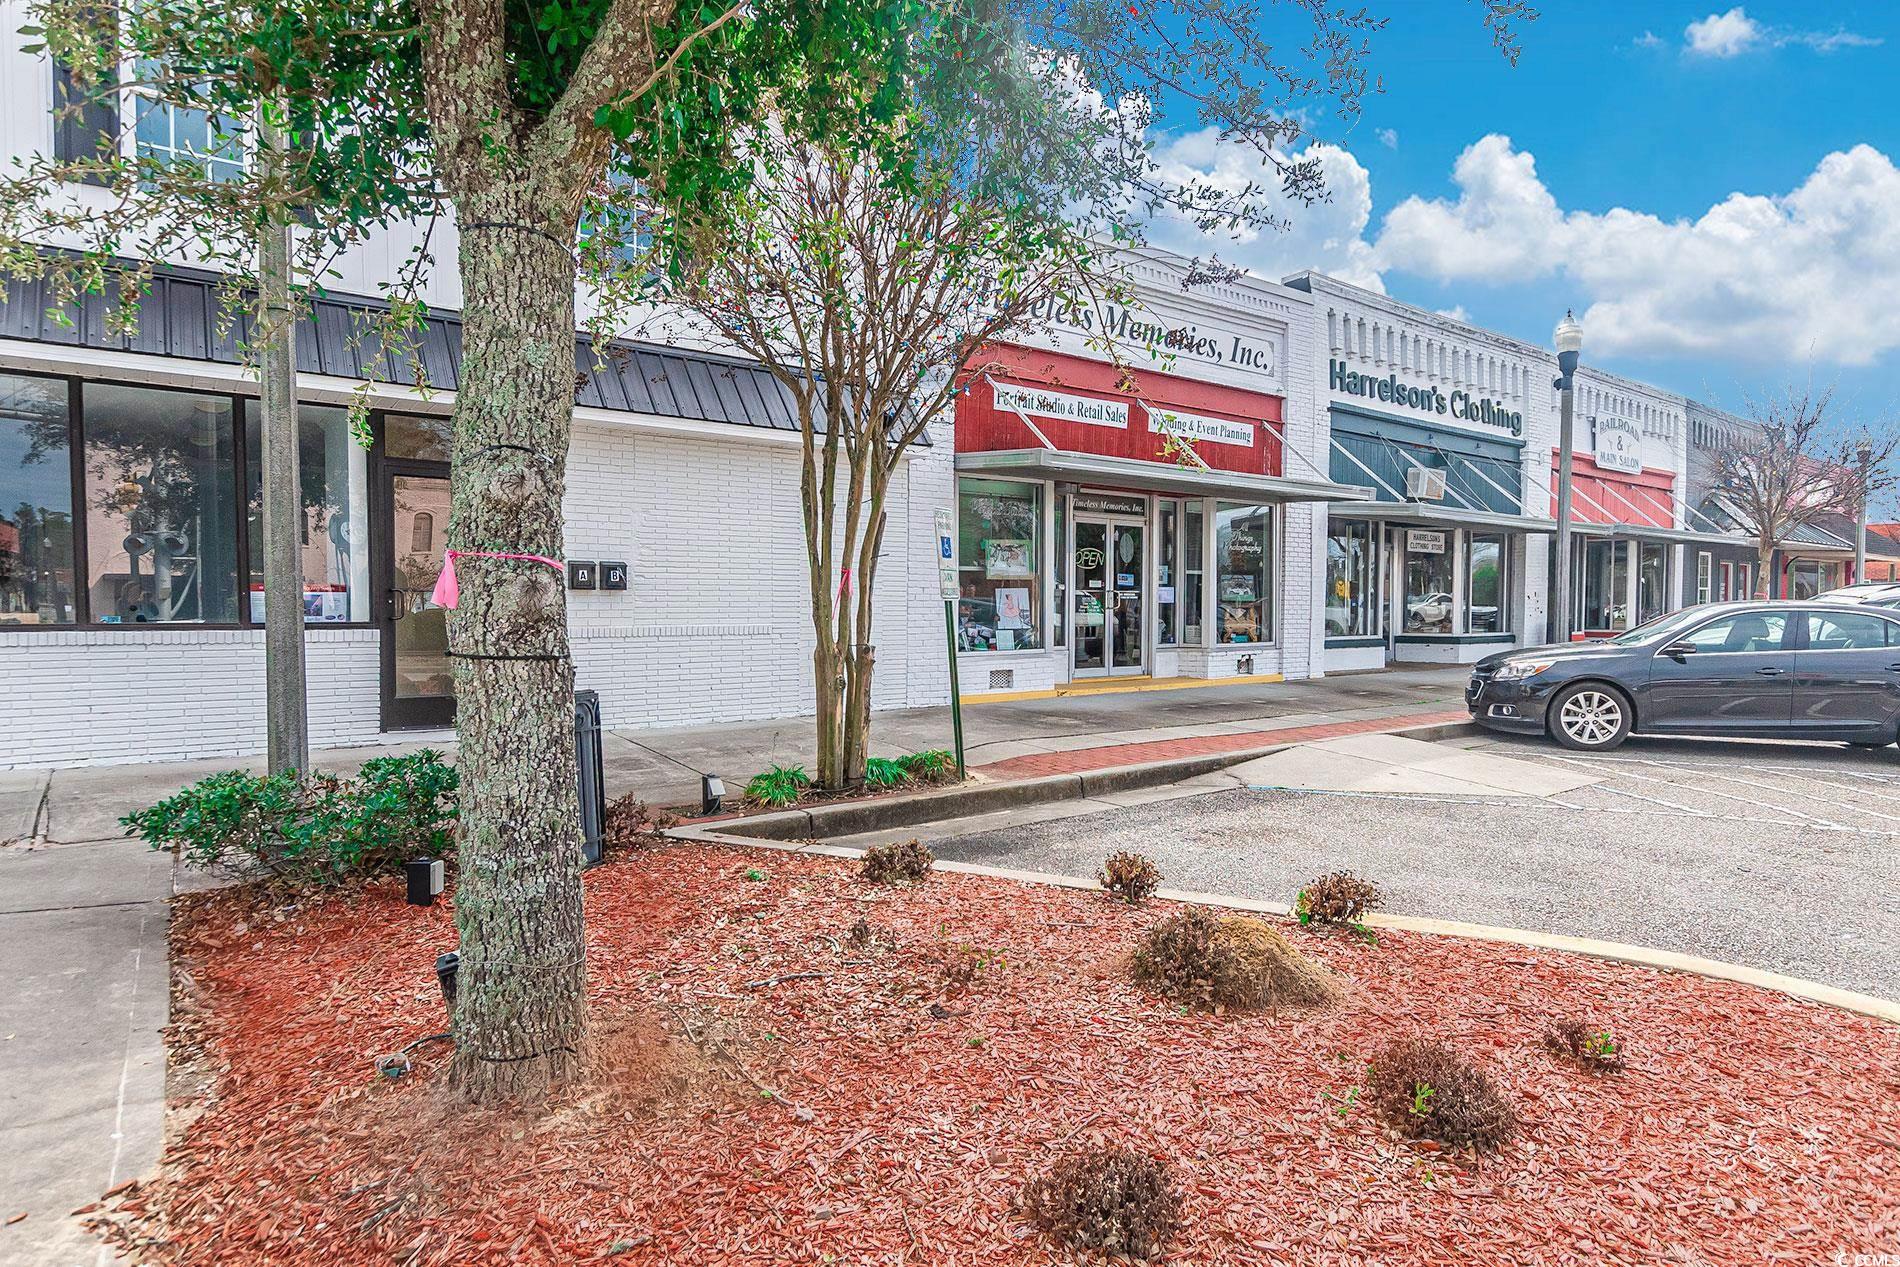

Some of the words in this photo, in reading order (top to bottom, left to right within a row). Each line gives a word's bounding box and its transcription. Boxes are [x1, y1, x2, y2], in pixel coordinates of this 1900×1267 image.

[1104, 304, 1223, 363] Memoies,
[1229, 336, 1269, 370] Inc.
[1036, 394, 1066, 414] Studio
[1068, 402, 1075, 415] &
[1077, 401, 1103, 420] Retail
[1105, 404, 1127, 424] Sales
[1329, 358, 1447, 415] Harrelson's
[1451, 390, 1522, 437] Clothing
[1189, 419, 1195, 431] &
[1197, 420, 1218, 437] Event
[1220, 425, 1251, 444] Planning
[1600, 417, 1640, 442] RAILROAD
[1617, 435, 1624, 451] &
[1600, 451, 1617, 464] MAIN
[1619, 455, 1640, 469] SALON
[1075, 551, 1105, 566] OPEN
[580, 571, 587, 580] A
[612, 571, 619, 581] B
